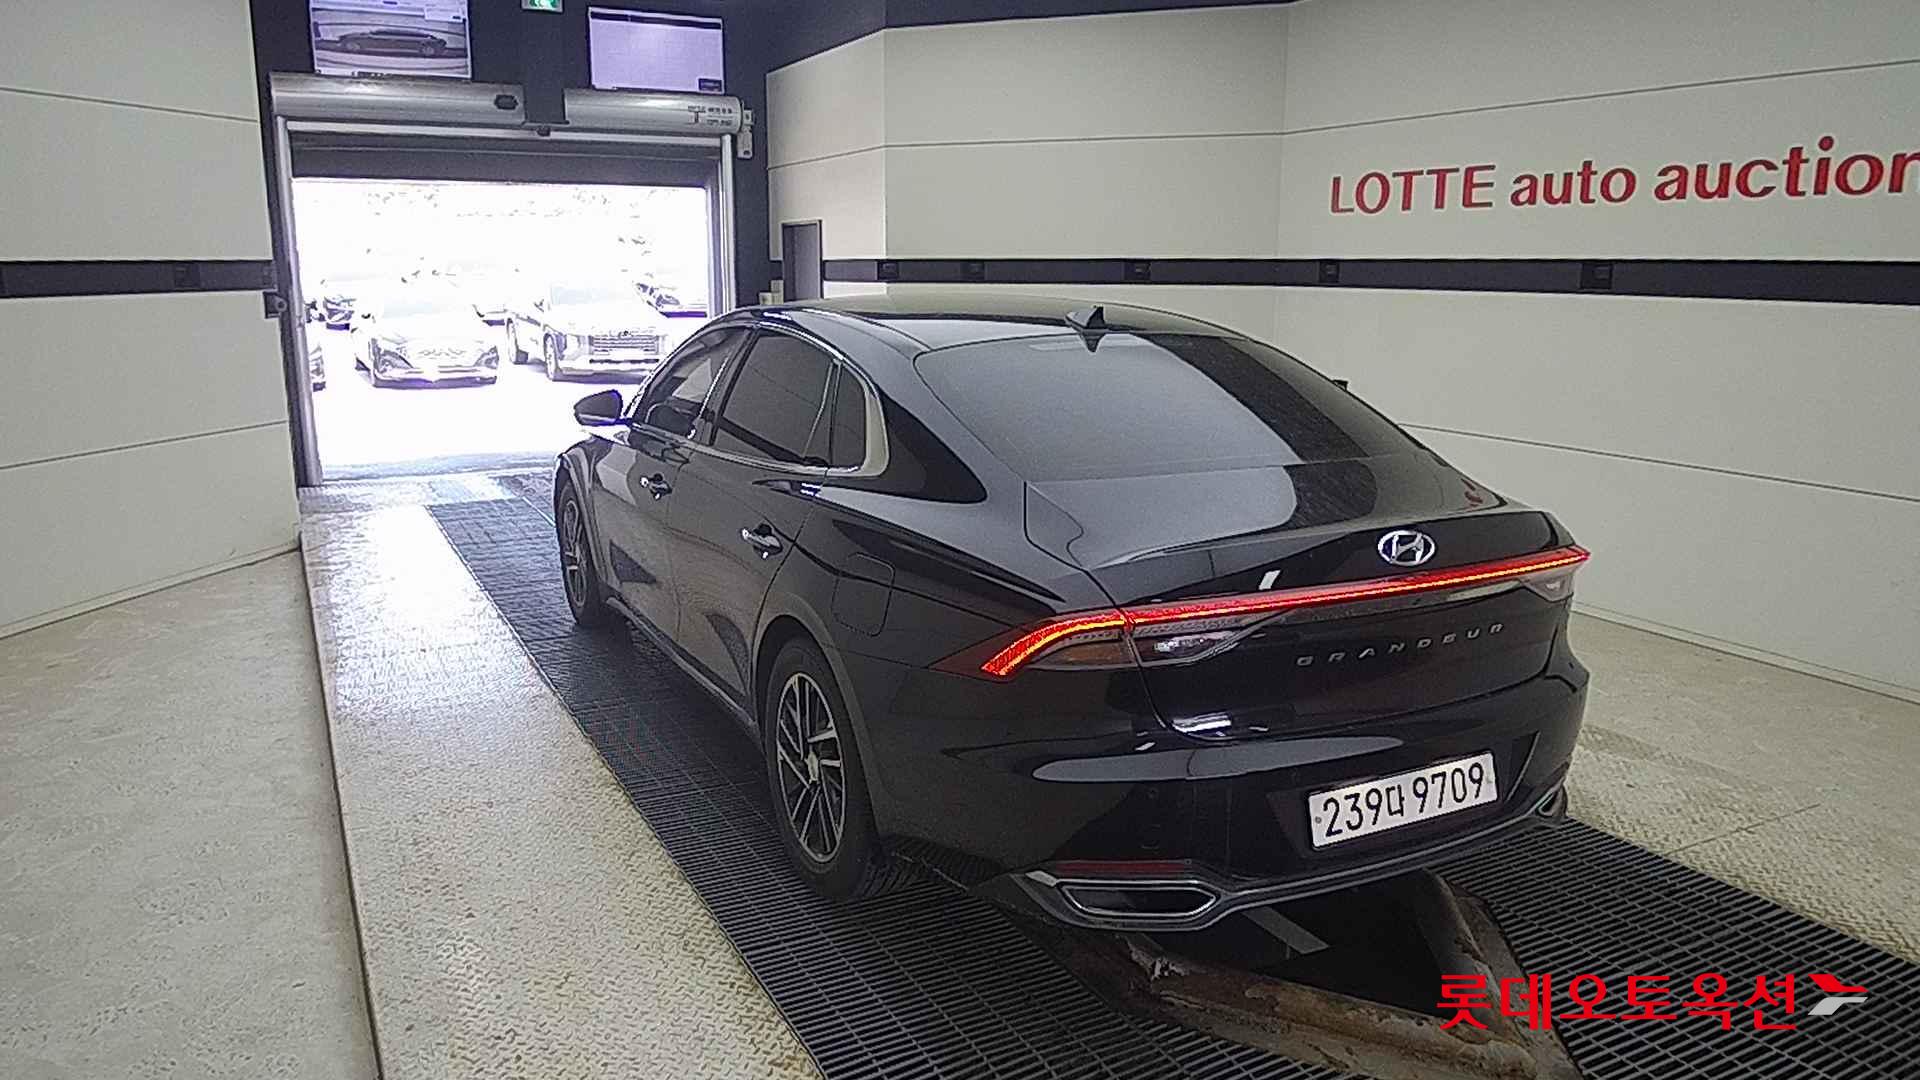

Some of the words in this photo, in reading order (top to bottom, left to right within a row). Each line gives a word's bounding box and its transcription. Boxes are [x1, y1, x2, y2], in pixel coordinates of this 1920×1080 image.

[1330, 165, 1496, 214] LOTTE
[1510, 160, 1637, 206] auto
[1297, 623, 1503, 666] GRANDEUR
